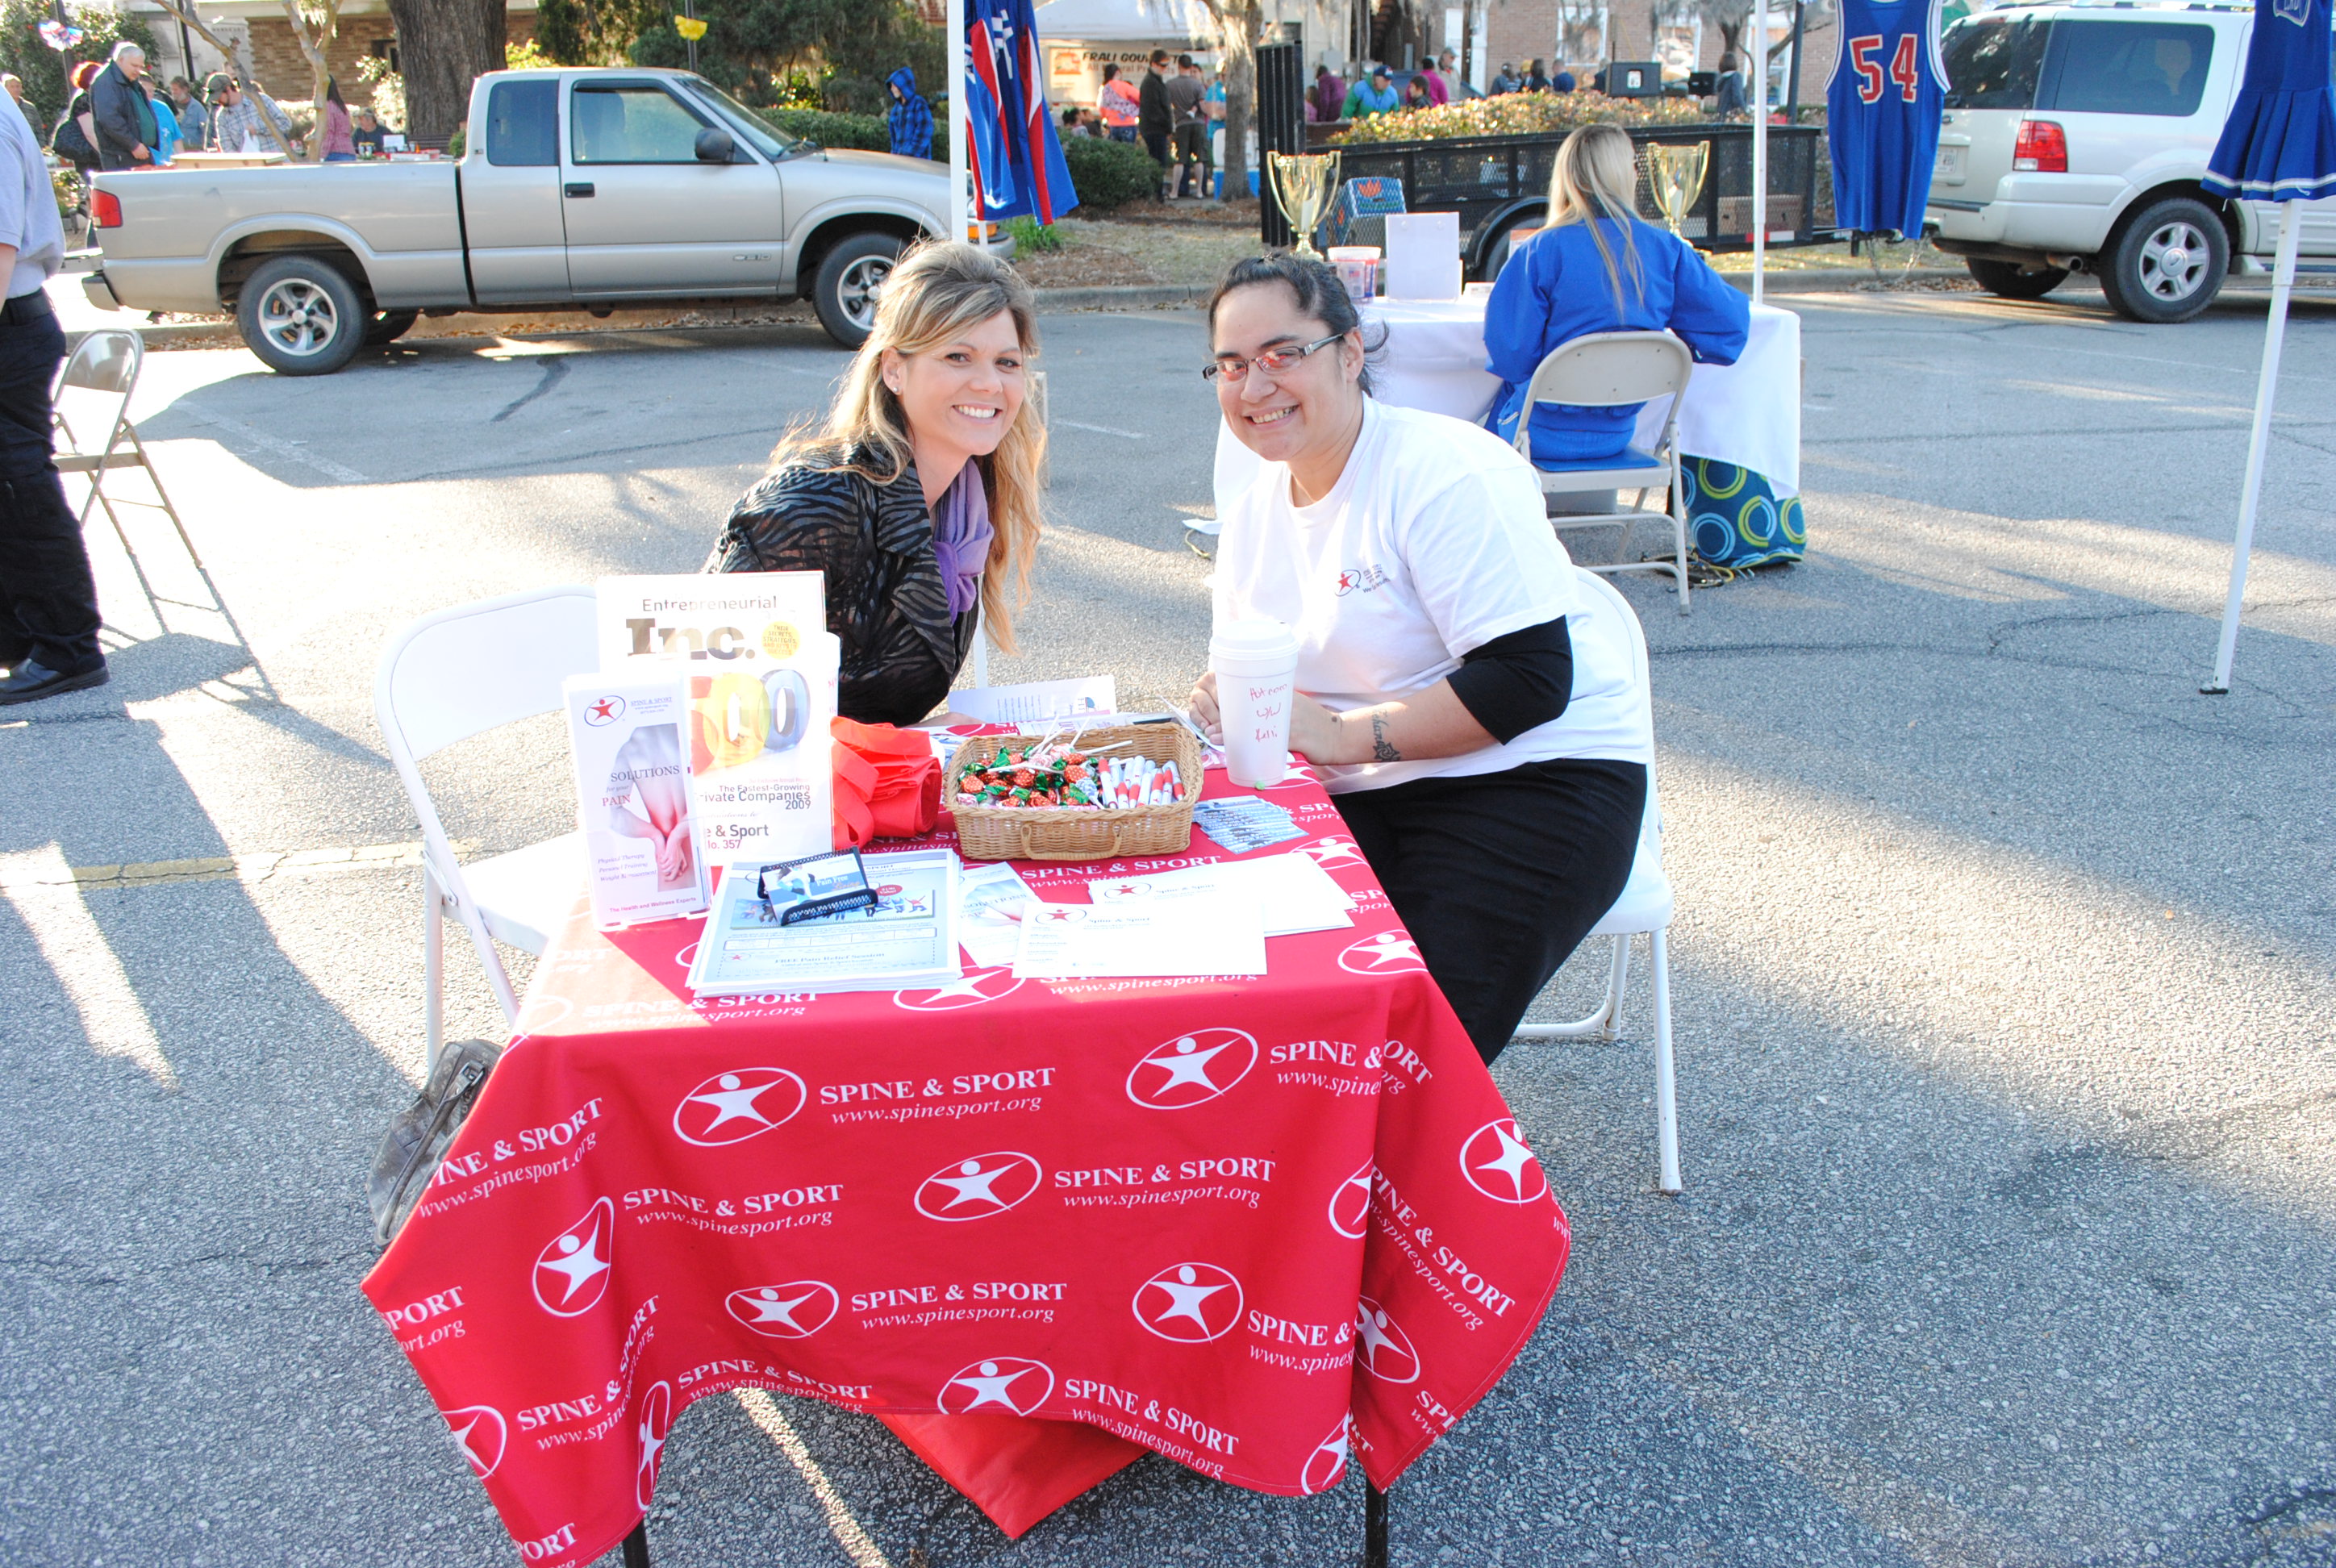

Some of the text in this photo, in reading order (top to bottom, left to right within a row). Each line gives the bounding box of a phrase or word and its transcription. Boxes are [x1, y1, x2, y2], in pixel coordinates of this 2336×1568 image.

[1082, 52, 1116, 60] FRALI
[1849, 33, 1918, 104] 54
[642, 595, 777, 611] Entrepreneurial
[626, 618, 756, 661] Inc.
[611, 765, 681, 782] SOLUTIONS
[720, 783, 811, 793] The Fastest-Growing
[602, 794, 631, 807] PAIN
[738, 790, 811, 803] Companies
[785, 799, 811, 810] 2009
[708, 840, 741, 849] o. 357
[715, 824, 726, 837] &
[730, 824, 769, 840] Sport
[816, 874, 849, 886] Pain Free
[1021, 865, 1102, 879] SPINE
[1108, 862, 1127, 873] &
[1134, 855, 1221, 870] SPORT
[1050, 974, 1258, 995] www.spinesport.org
[581, 992, 818, 1018] SPINE & SPORT
[588, 1006, 806, 1028] www.spinesport.org
[1270, 1040, 1357, 1067] SPINE
[1364, 1045, 1383, 1070] &
[820, 1068, 1056, 1105] SPINE & SPORT
[831, 1095, 1042, 1124] www.spinesport.org
[493, 1140, 516, 1161] &
[519, 1097, 604, 1153] SPORT
[419, 1131, 598, 1219] www.spinesport.org
[1055, 1157, 1277, 1189] SPINE & SPORT
[623, 1183, 844, 1218] SPINE & SPORT
[1062, 1183, 1261, 1209] www.spinesport.org
[636, 1208, 833, 1238] www.spinesport.org
[1415, 1226, 1433, 1248] &
[1432, 1245, 1516, 1318] SPORT
[850, 1282, 1067, 1312] SPINE & SPORT
[861, 1306, 1055, 1330] www.spinesport.org
[1248, 1309, 1329, 1346] SPINE
[1334, 1322, 1350, 1345] &
[516, 1294, 659, 1432] SPINE & SPORT
[678, 1359, 873, 1399] SPINE & SPORT
[1065, 1378, 1241, 1457] SPINE & SPORT
[1071, 1407, 1224, 1480] www.spinesport.org
